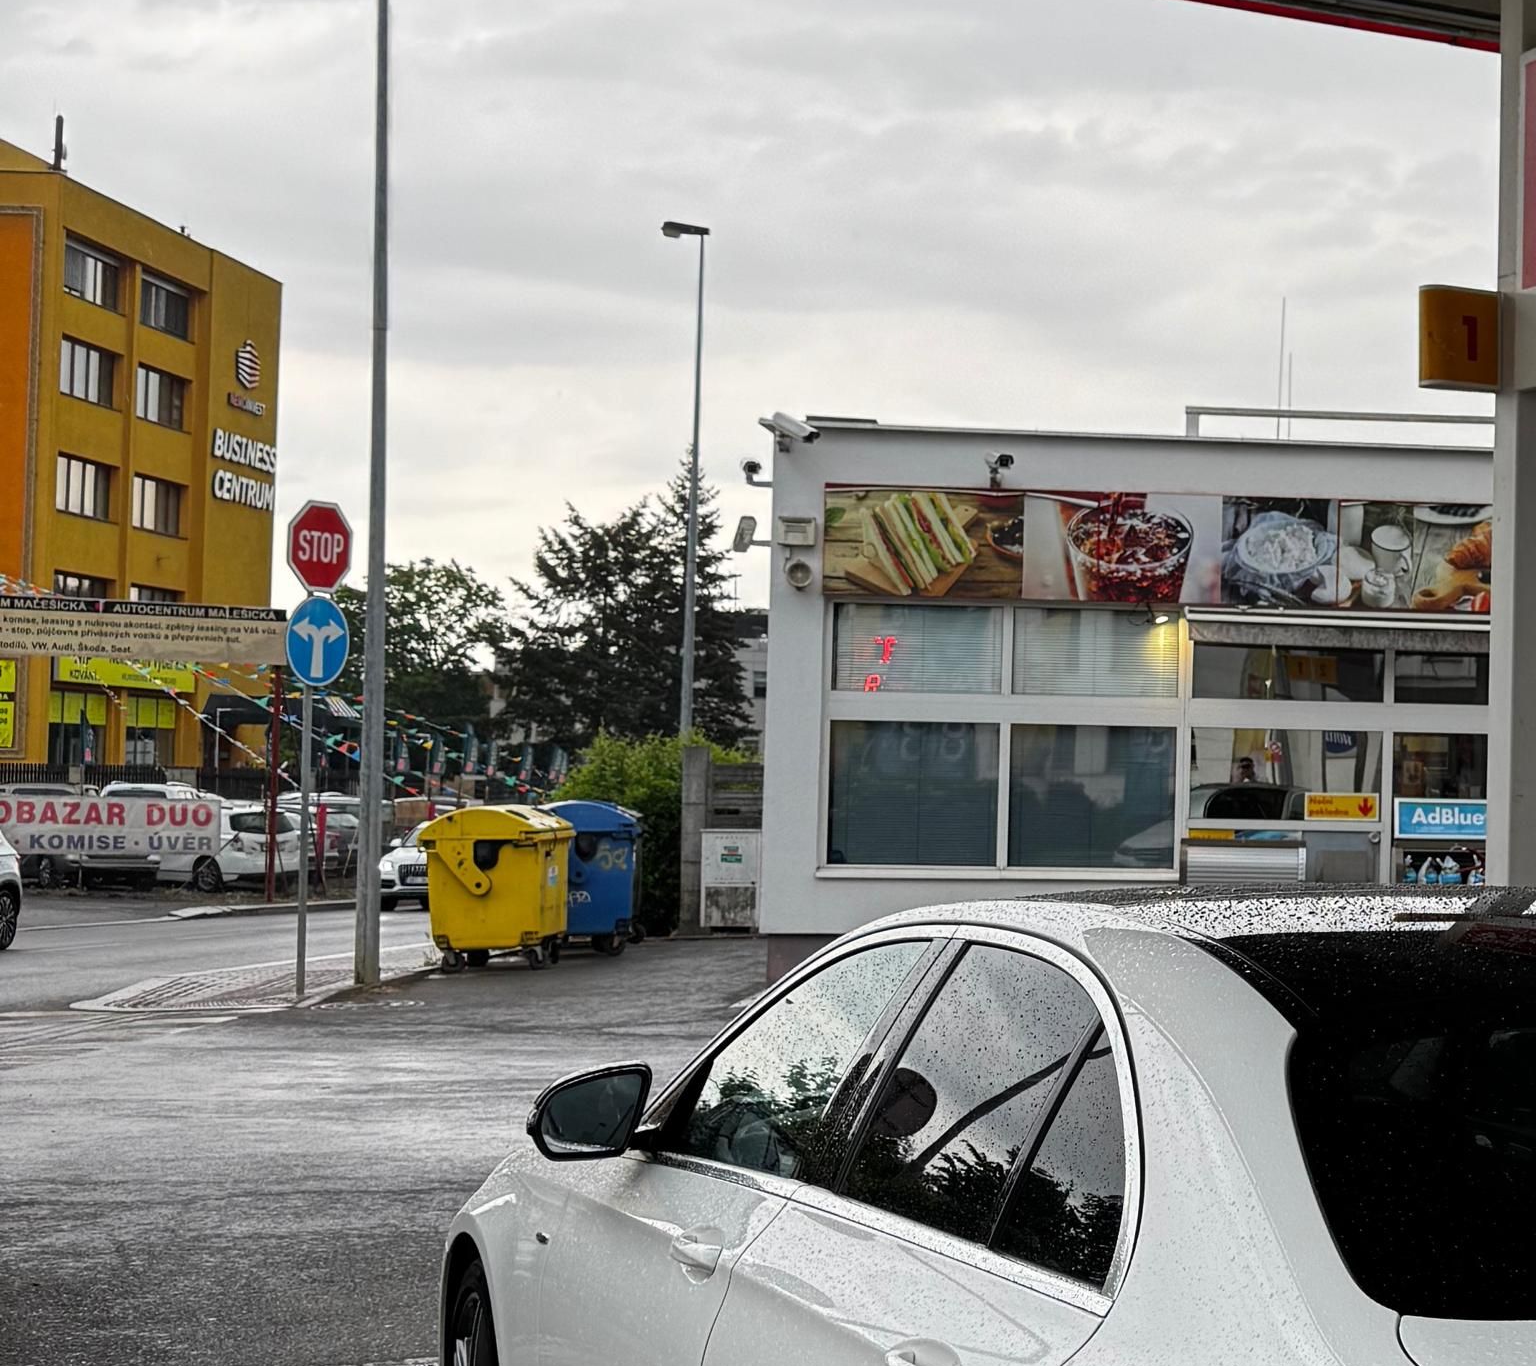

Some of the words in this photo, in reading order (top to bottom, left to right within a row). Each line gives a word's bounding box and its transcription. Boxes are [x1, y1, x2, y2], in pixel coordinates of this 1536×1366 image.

[1462, 315, 1478, 362] 1
[213, 428, 276, 474] BUSINESS
[214, 469, 275, 511] CENTRUM
[298, 529, 345, 565] STOP
[113, 603, 205, 618] AUTOCENTRUM
[42, 617, 74, 628] leasing
[85, 618, 121, 628] nulovou
[32, 642, 48, 651] VW,
[51, 643, 75, 652] Audi,
[146, 803, 213, 827] DUO
[1412, 807, 1485, 825] AdBlue
[29, 834, 126, 850] KOMISE
[148, 832, 213, 851] ÚVĚR
